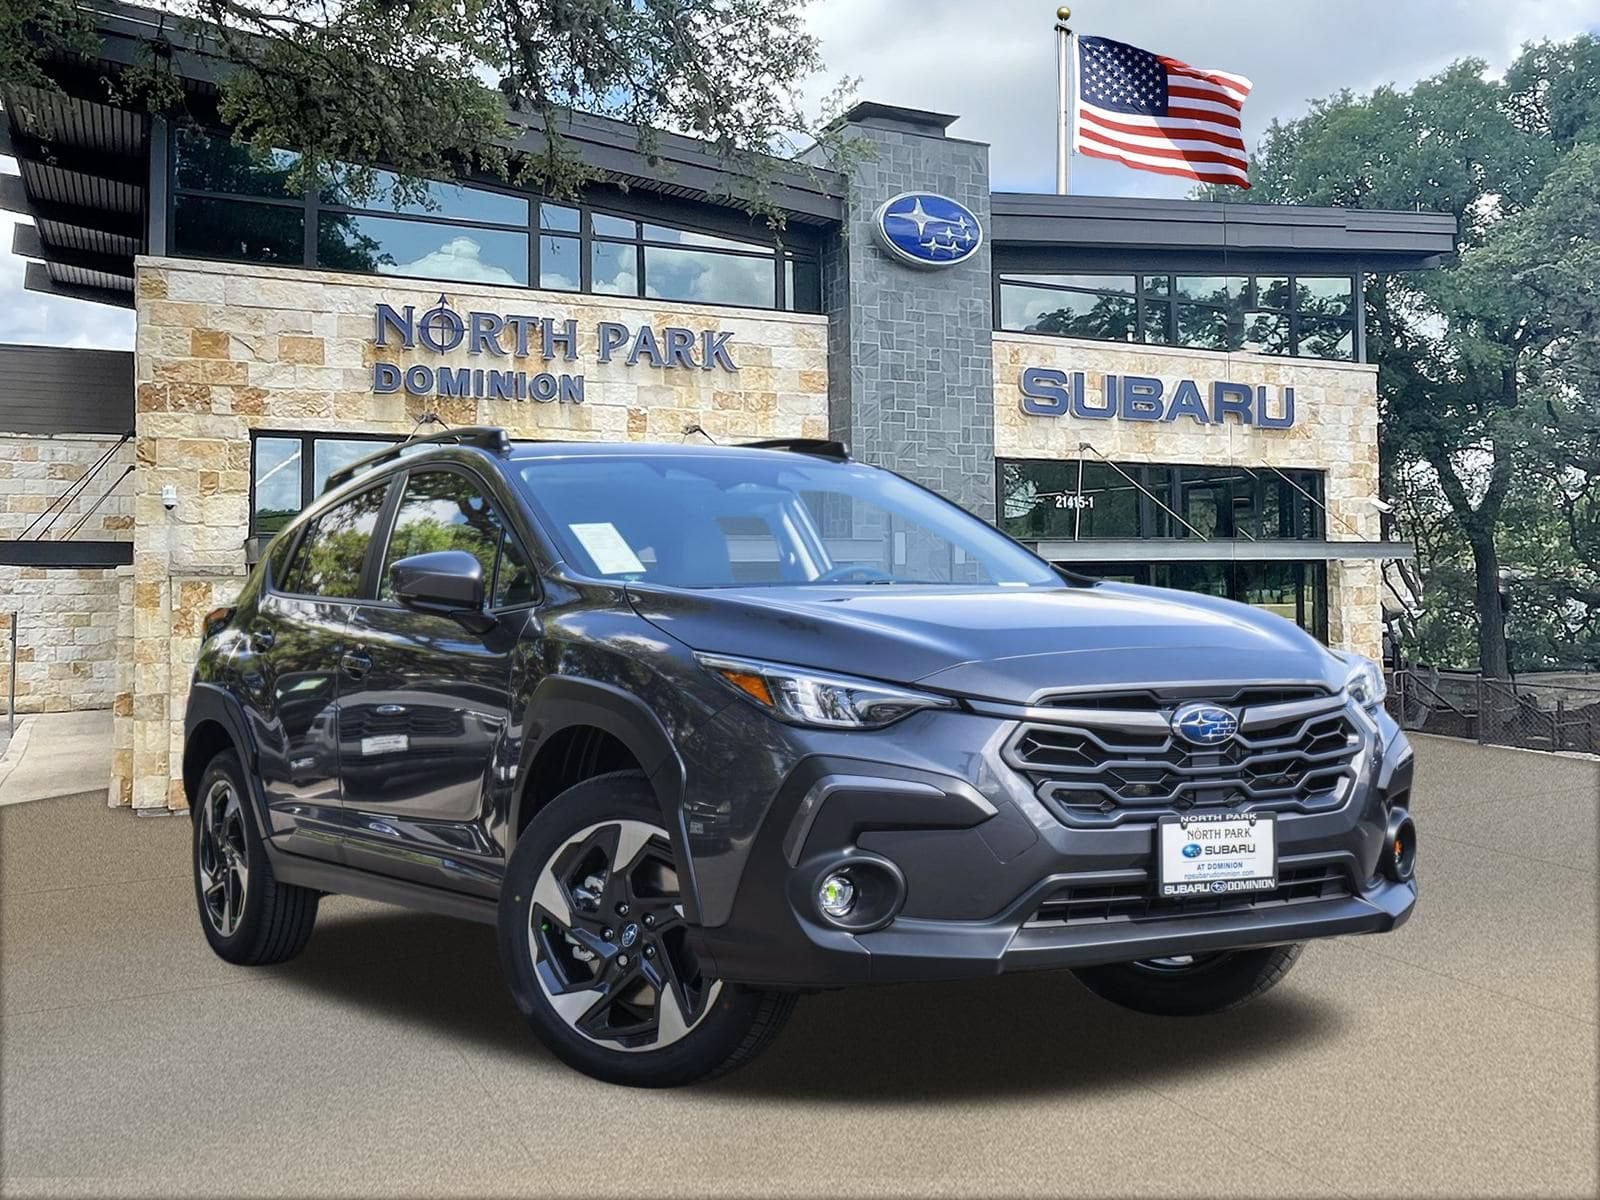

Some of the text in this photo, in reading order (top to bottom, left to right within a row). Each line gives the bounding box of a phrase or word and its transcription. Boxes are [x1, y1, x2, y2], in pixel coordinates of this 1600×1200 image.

[374, 294, 741, 373] NORTH PARK
[373, 362, 585, 404] DOMINION
[1019, 367, 1295, 430] SUBARU
[1187, 828, 1252, 840] NORTH PARK
[1204, 844, 1256, 855] SUBARU
[1197, 862, 1243, 871] AT DOMINION
[1164, 879, 1276, 895] SUBARU DOMINION
